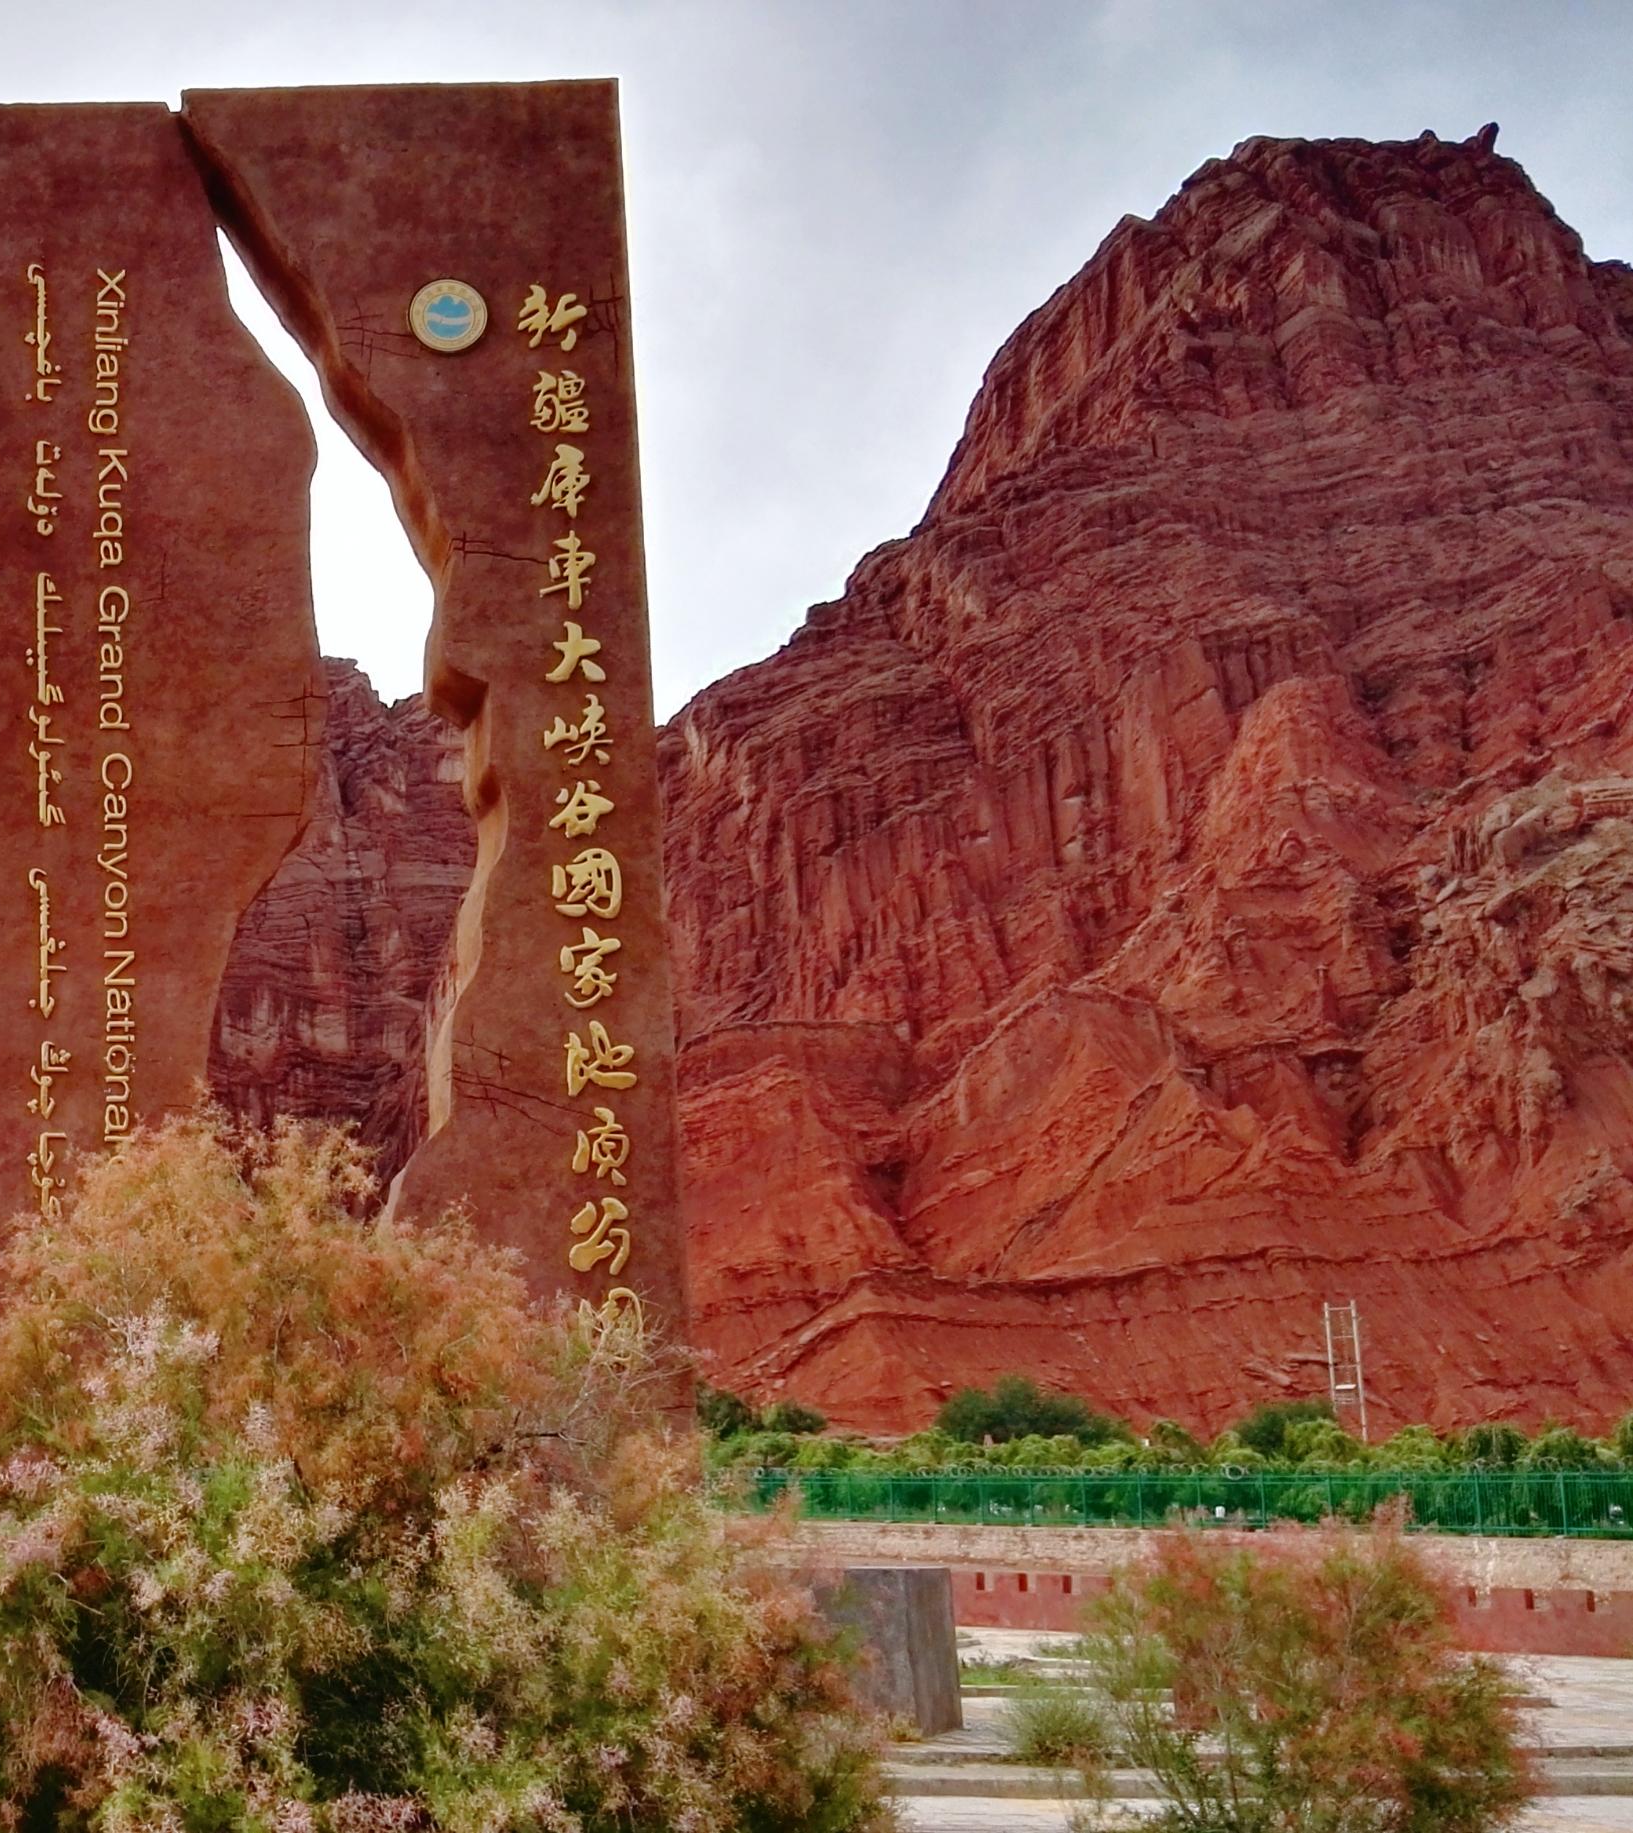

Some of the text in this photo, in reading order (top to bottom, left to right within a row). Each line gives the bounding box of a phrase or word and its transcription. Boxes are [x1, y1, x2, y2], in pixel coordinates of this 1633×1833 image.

[88, 268, 127, 435] Xinjiang
[92, 449, 128, 569] Kuqa
[98, 585, 130, 730] Grand
[96, 752, 133, 939] Canyon
[102, 949, 137, 1142] National
